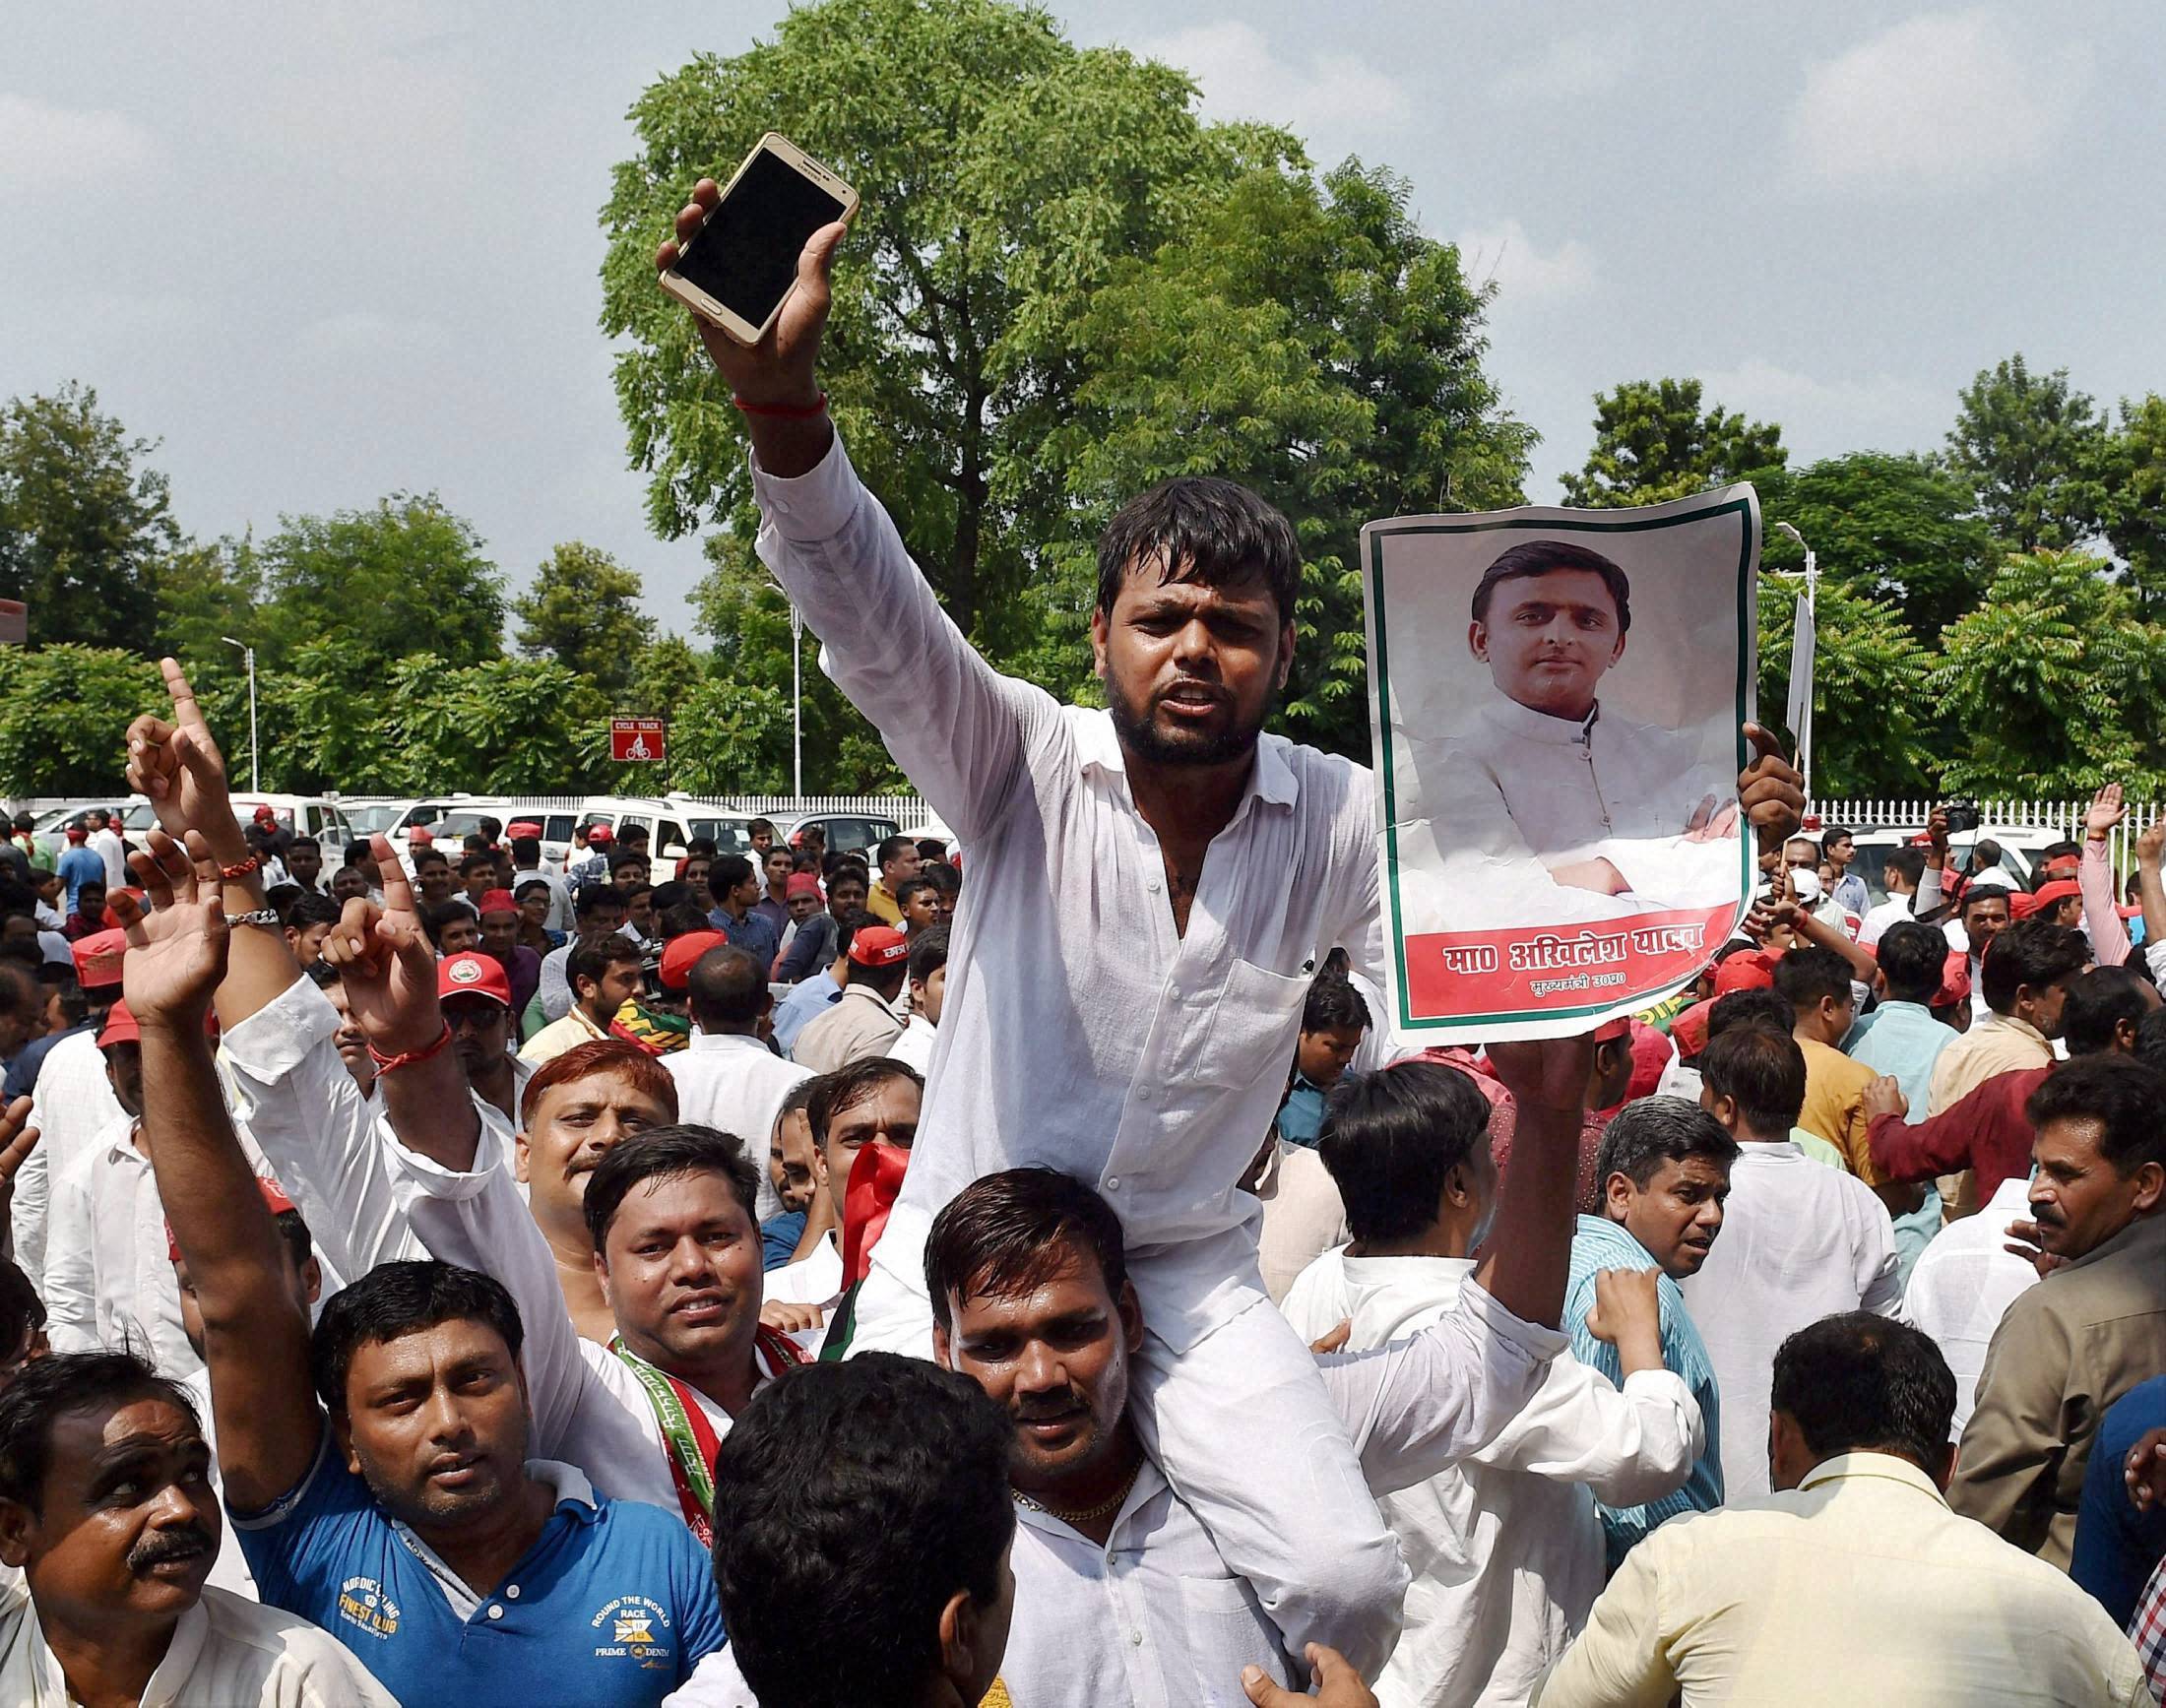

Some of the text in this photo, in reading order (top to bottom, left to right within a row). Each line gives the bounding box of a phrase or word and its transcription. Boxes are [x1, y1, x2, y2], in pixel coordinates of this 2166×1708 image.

[1509, 931, 1627, 971] अखिलेश
[1631, 923, 1706, 955] यादव
[339, 1594, 373, 1622] FINEST
[591, 1596, 670, 1628] ROUND THE WORLD
[620, 1609, 647, 1618] RACE
[595, 1647, 669, 1657] PRIME DENIM
